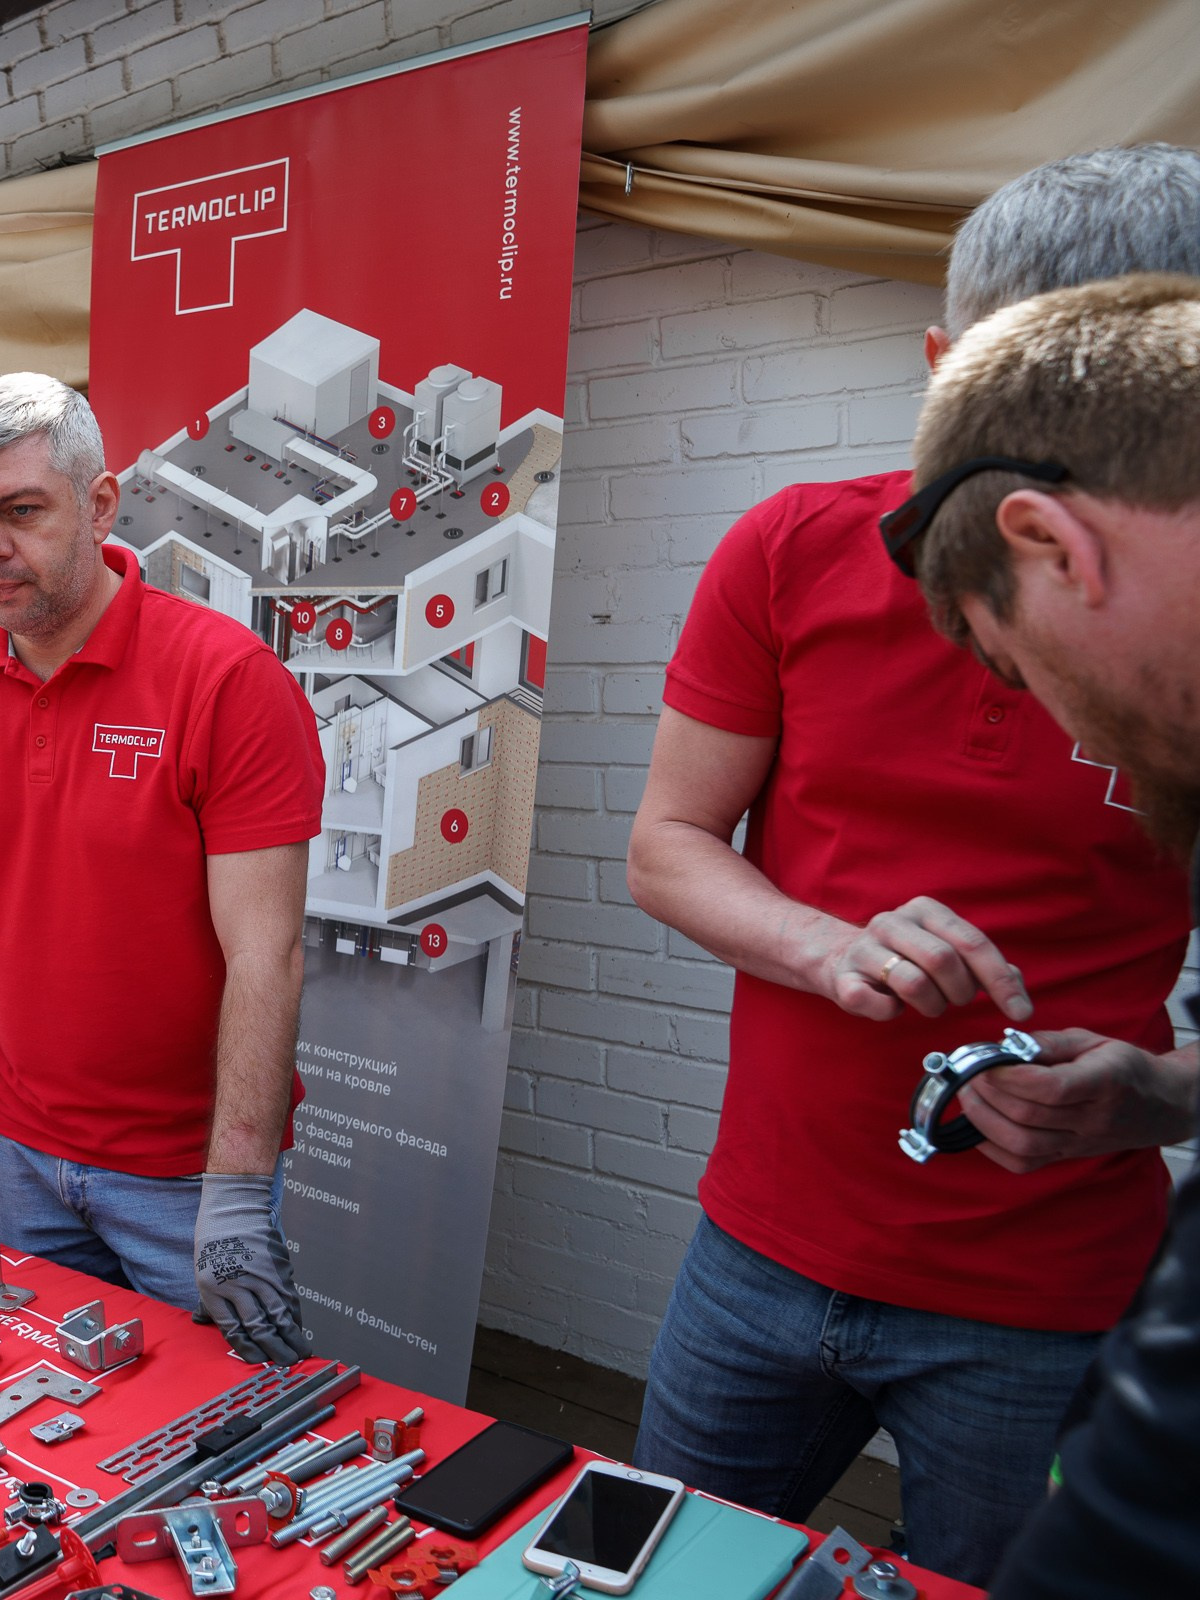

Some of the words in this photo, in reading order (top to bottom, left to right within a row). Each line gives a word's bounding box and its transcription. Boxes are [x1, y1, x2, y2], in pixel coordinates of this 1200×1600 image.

[144, 186, 276, 234] TERMOCLIP
[498, 106, 522, 300] www.termoclip.ru
[195, 420, 201, 431] 1
[377, 416, 387, 429] 3
[399, 497, 407, 511] 7
[491, 492, 500, 506] 2
[297, 611, 310, 624] 10
[435, 604, 444, 618] 5
[335, 628, 343, 641] 8
[99, 733, 158, 747] TERMOCLIP
[450, 819, 459, 833] 6
[428, 933, 440, 948] 13
[314, 1044, 398, 1077] конструкций
[326, 1068, 341, 1082] на
[345, 1073, 391, 1096] кровле
[306, 1122, 353, 1149] фасада
[396, 1129, 448, 1158] фасада
[308, 1145, 352, 1169] кладки
[345, 1305, 354, 1318] и
[356, 1308, 438, 1355] фальш-стен
